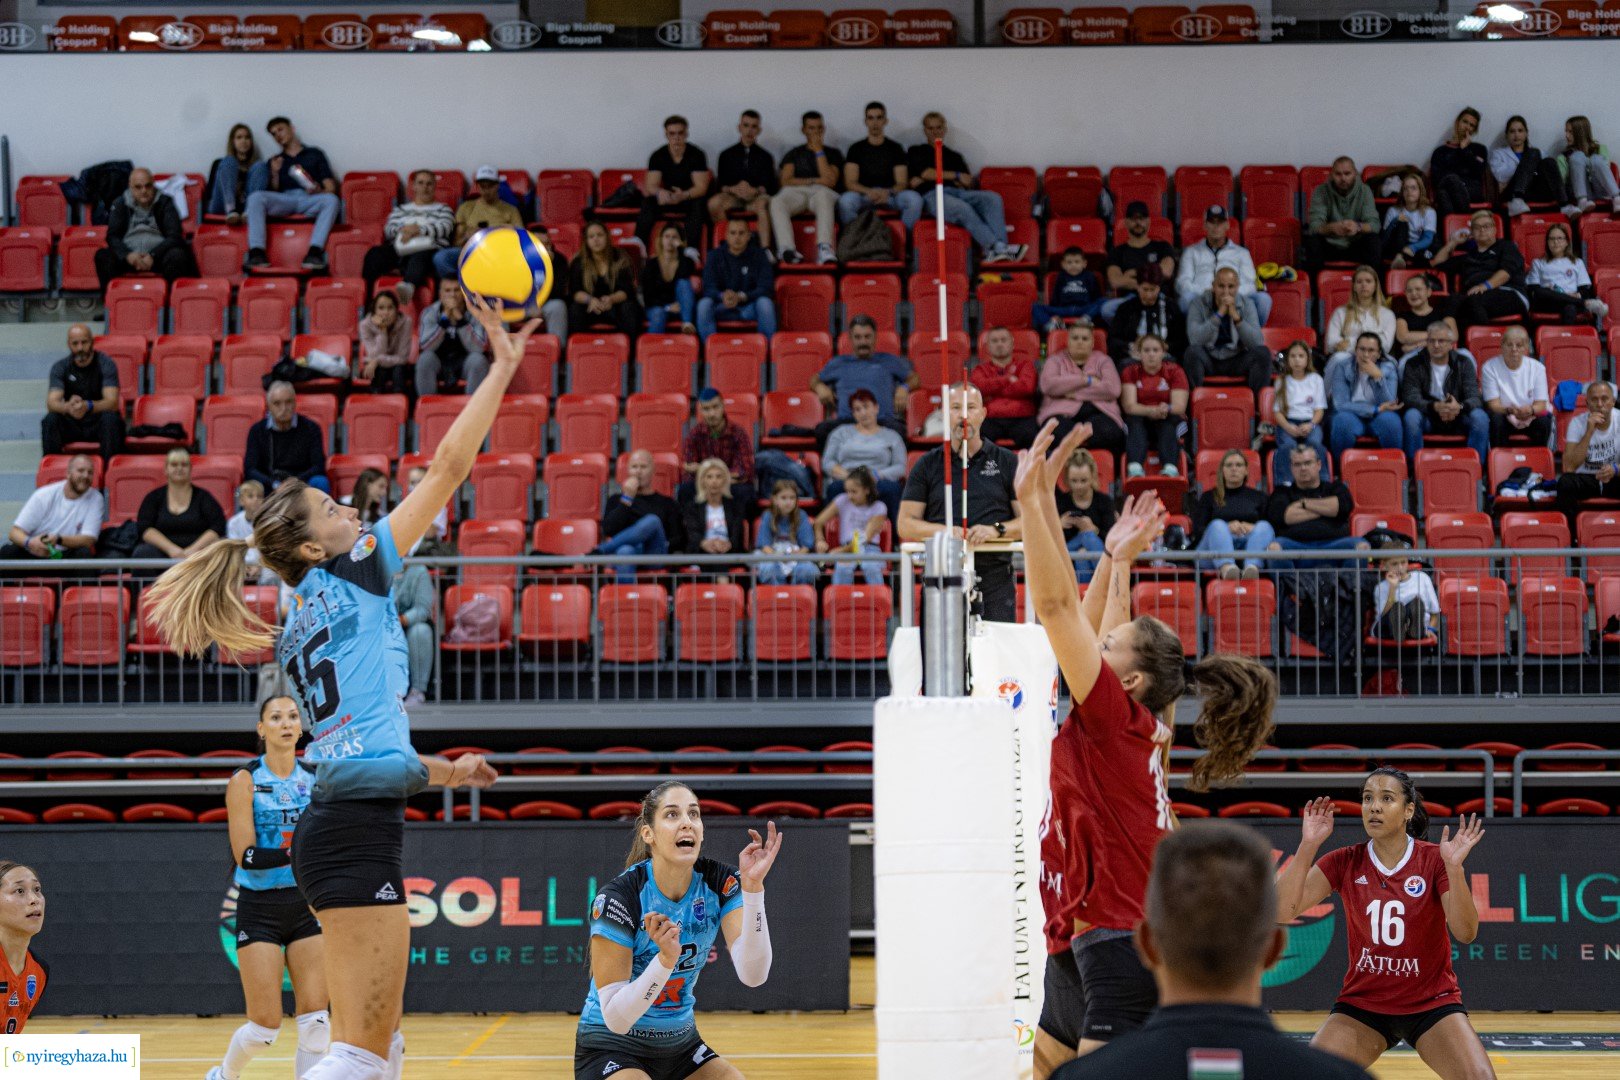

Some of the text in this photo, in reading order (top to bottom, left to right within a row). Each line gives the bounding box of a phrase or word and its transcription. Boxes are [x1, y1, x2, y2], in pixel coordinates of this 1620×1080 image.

[1227, 15, 1252, 25] Bige
[1567, 9, 1593, 20] Bige
[573, 22, 615, 33] Holding
[711, 21, 780, 32] Bige Holding
[884, 19, 952, 30] Bige Holding
[1059, 17, 1128, 28] Bige Holding
[1181, 18, 1213, 37] BH
[1350, 15, 1382, 34] BH
[1521, 13, 1551, 31] BH
[69, 25, 110, 36] Holding
[208, 24, 278, 36] Bige Holding
[331, 26, 363, 44] BH
[502, 25, 533, 43] BH
[666, 24, 699, 42] BH
[838, 22, 870, 40] BH
[1012, 20, 1044, 39] BH
[1072, 29, 1115, 40] Csoport
[54, 37, 97, 47] Csoport
[221, 36, 265, 46] Csoport
[558, 35, 602, 45] Csoport
[725, 33, 768, 43] Csoport
[896, 32, 940, 42] Csoport
[285, 624, 341, 727] 15
[375, 891, 399, 900] PEAK
[606, 911, 625, 925] LUGOJ
[1366, 899, 1405, 947] 16
[409, 946, 584, 965] HE GREEN
[671, 941, 698, 972] 2
[1356, 947, 1420, 973] FATUM
